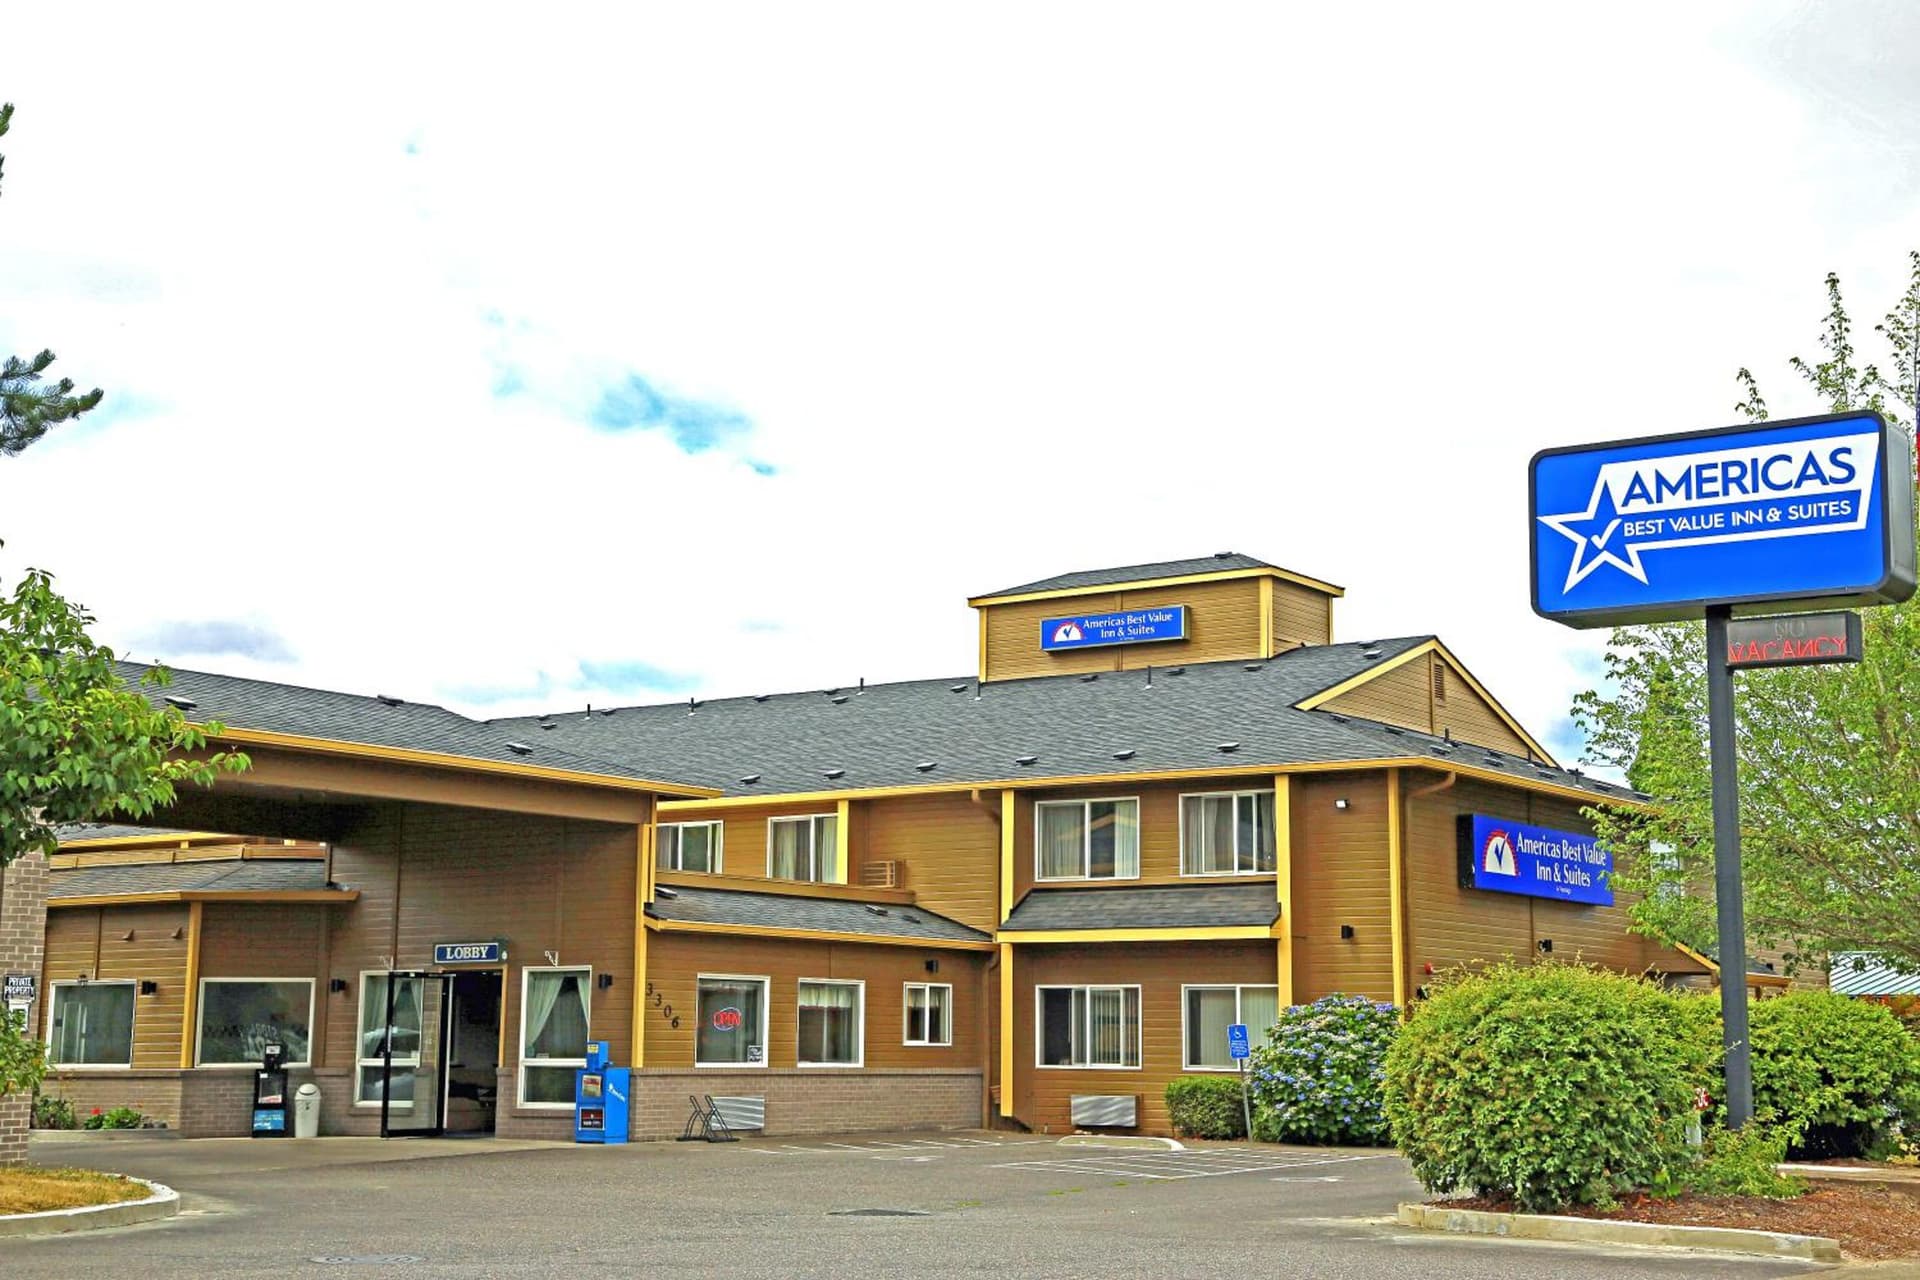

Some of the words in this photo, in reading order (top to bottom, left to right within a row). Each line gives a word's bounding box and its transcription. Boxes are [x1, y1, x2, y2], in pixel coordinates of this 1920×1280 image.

[1621, 447, 1856, 507] AMERICAS
[1623, 518, 1665, 537] BEST
[1669, 513, 1725, 532] VALUE
[1731, 508, 1763, 526] INN
[1766, 507, 1782, 522] &
[1788, 500, 1852, 520] SUITES
[1083, 616, 1125, 629] Americas
[1127, 614, 1146, 625] Best
[1148, 611, 1173, 623] Value
[1774, 618, 1805, 637] NO
[1101, 628, 1116, 639] Inn
[1118, 627, 1125, 637] &
[1127, 624, 1155, 637] Suites
[1729, 634, 1846, 662] VACANCY
[1516, 831, 1561, 859] Americas
[1562, 839, 1581, 862] Best
[1583, 843, 1607, 866] Value
[1536, 860, 1552, 881] Inn
[1553, 864, 1562, 882] &
[1563, 863, 1591, 887] Suites
[446, 946, 489, 959] LOBBY
[8, 977, 31, 987] PRIVATE
[715, 1012, 740, 1025] OPEN
